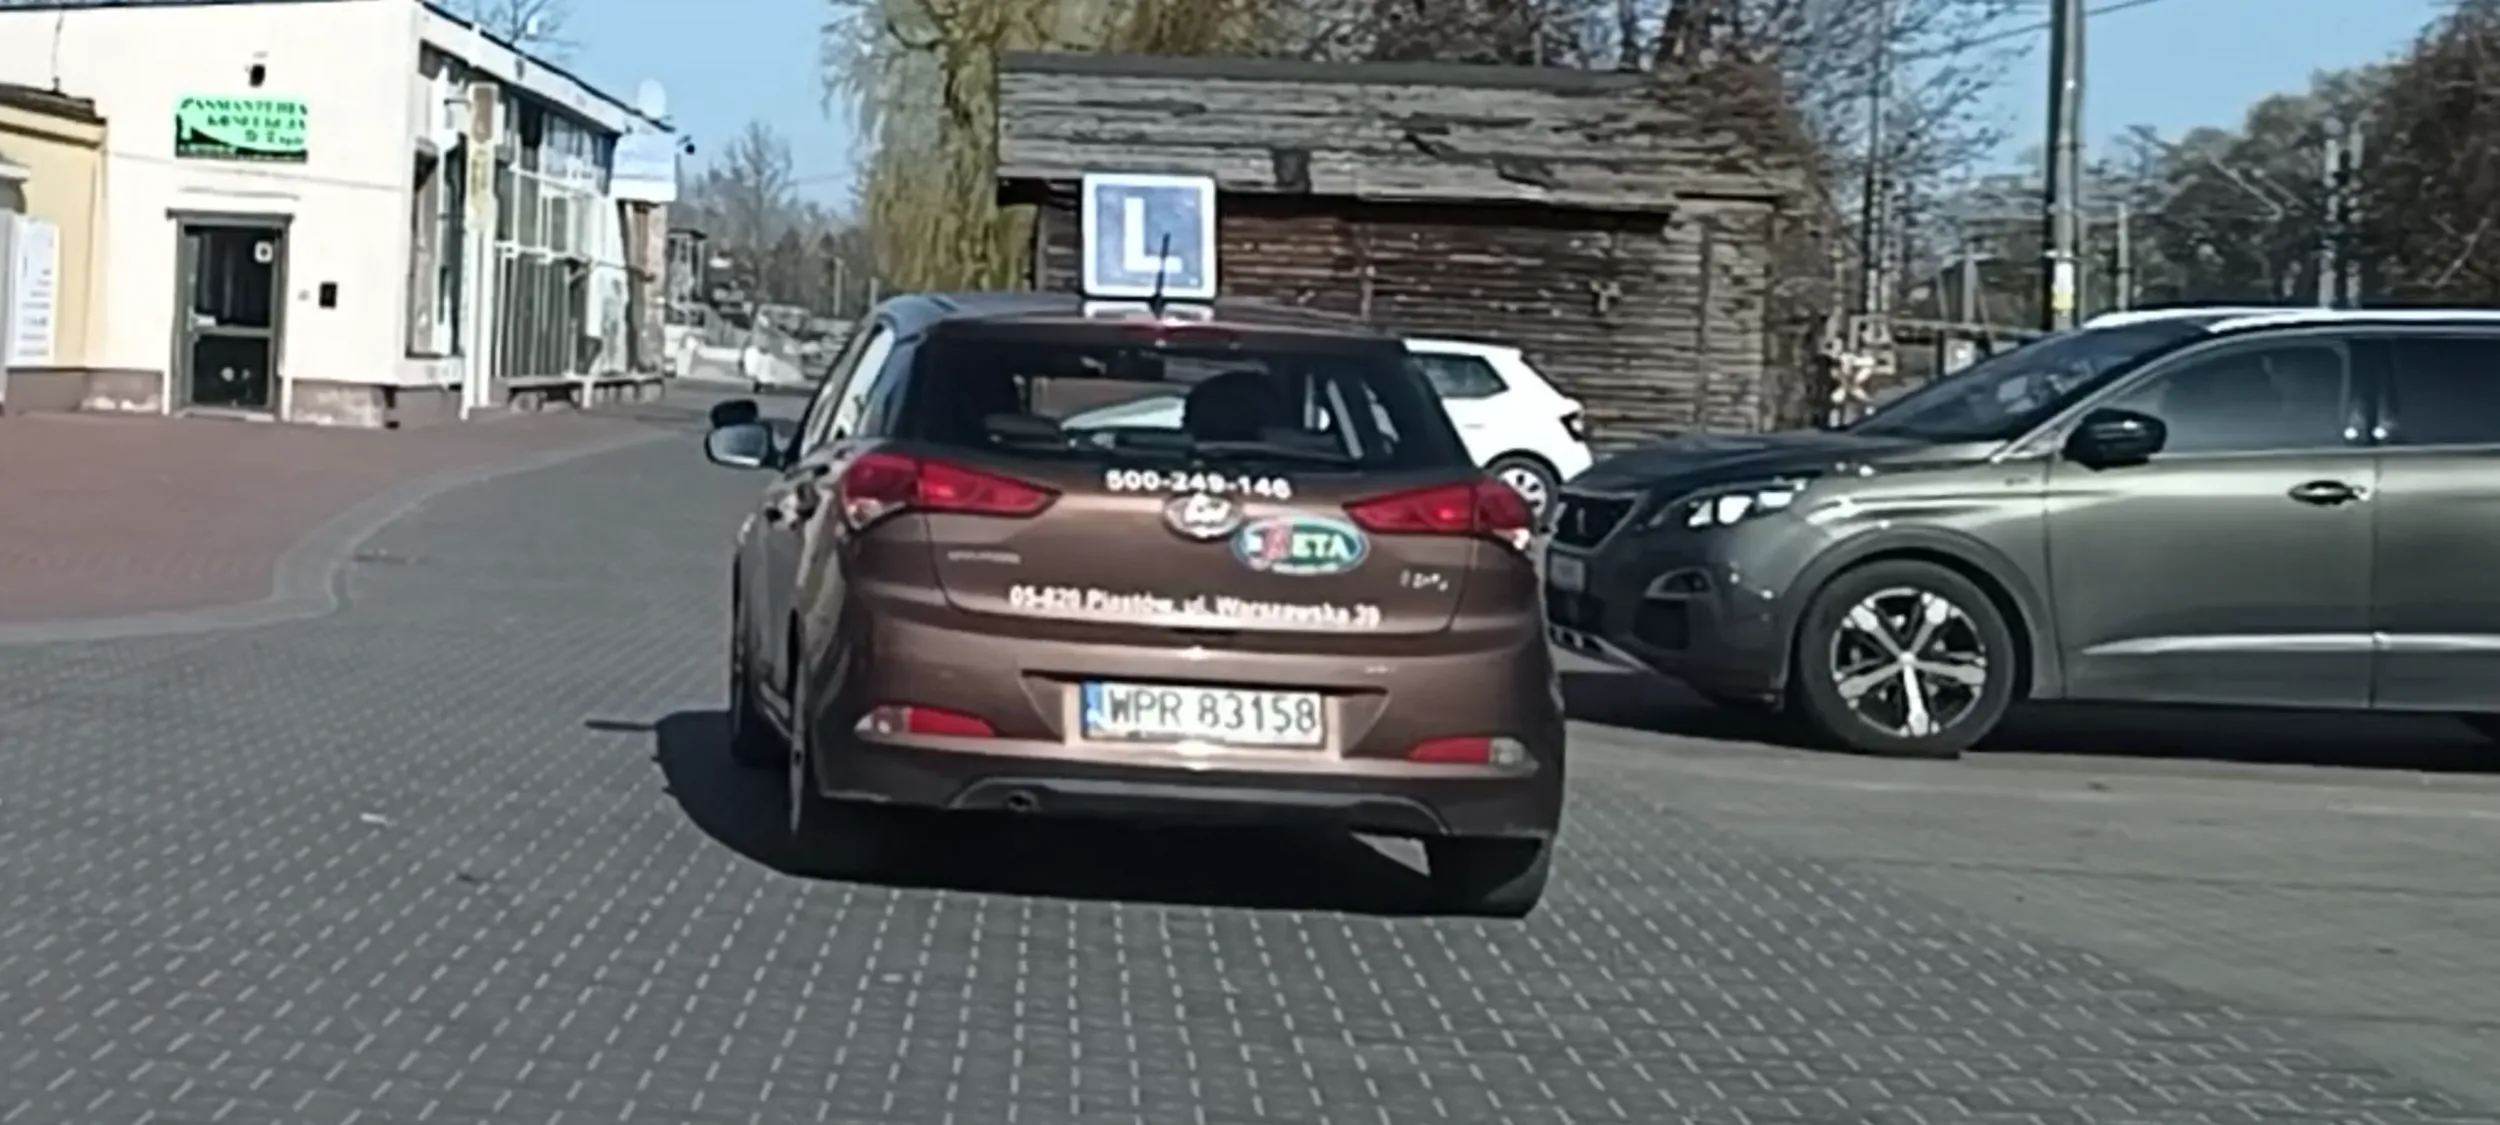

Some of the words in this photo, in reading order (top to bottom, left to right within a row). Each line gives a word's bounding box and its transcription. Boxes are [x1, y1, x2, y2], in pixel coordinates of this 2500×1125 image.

[1124, 196, 1182, 273] L
[1108, 687, 1182, 726] WPR
[1198, 693, 1317, 734] 83158
